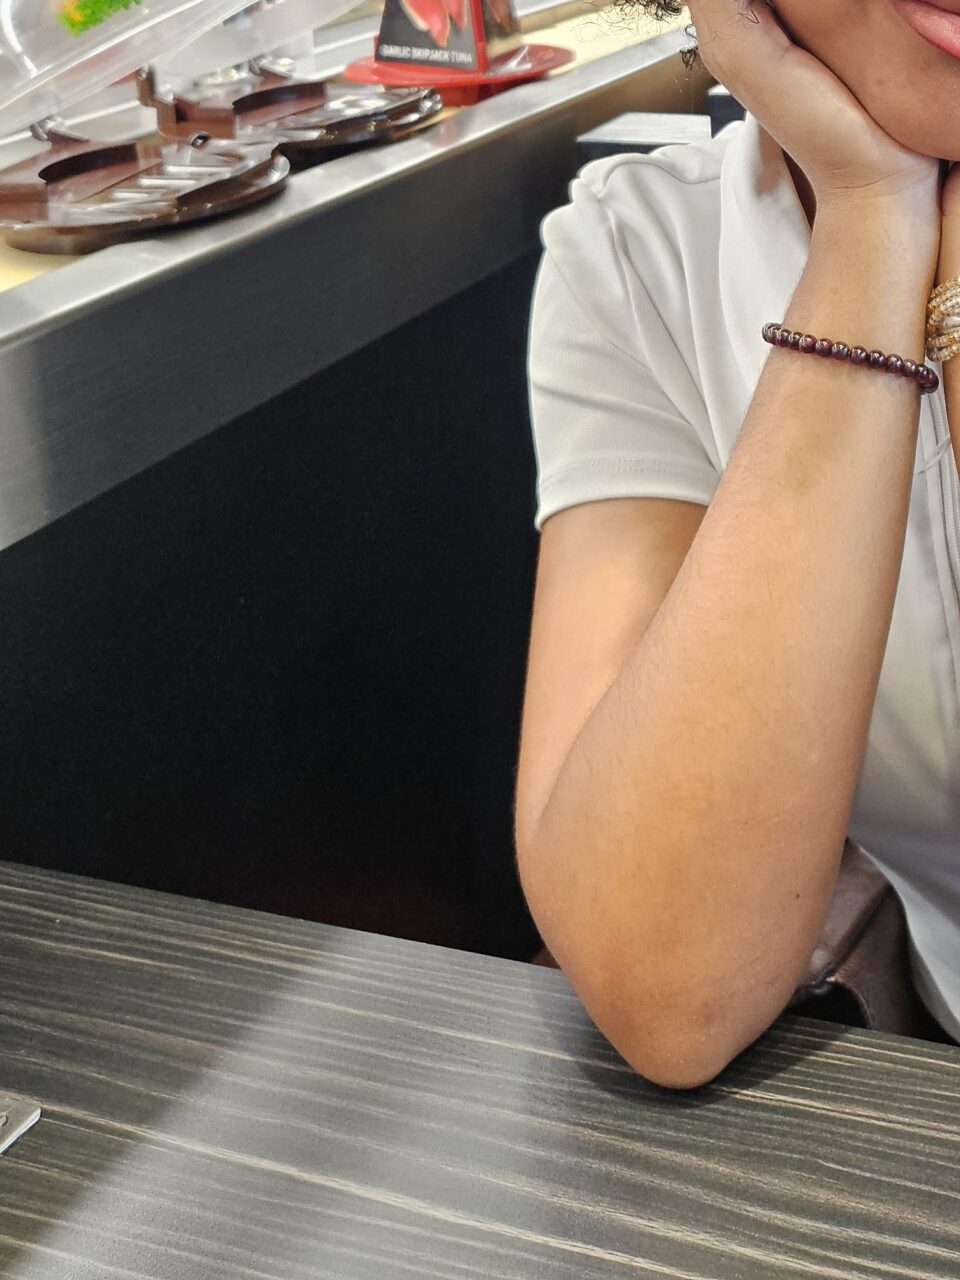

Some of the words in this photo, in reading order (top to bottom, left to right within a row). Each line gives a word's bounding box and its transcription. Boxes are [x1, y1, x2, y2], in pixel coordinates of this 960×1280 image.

[381, 43, 411, 59] GARLIC
[411, 46, 450, 61] SKIPJACK
[450, 50, 473, 64] TUNA
